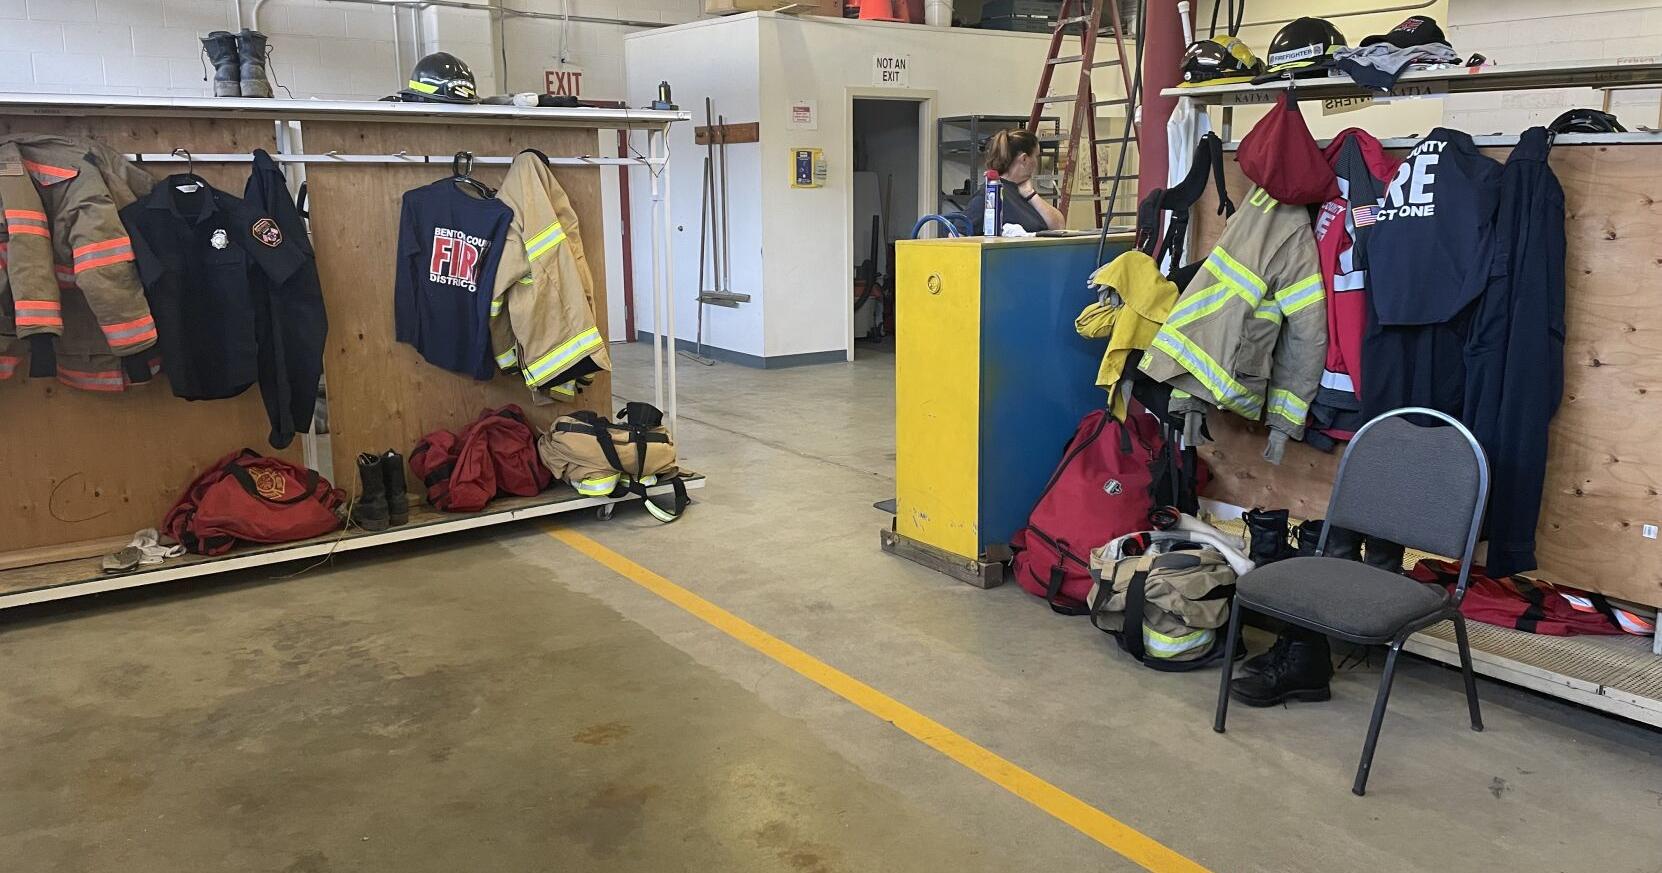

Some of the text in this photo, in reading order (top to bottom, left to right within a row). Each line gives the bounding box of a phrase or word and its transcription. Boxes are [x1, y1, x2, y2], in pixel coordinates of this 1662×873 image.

[876, 57, 906, 70] NOT AN
[1273, 49, 1313, 62] FIREFIGHTER
[545, 71, 582, 97] EXIT
[883, 71, 900, 82] EXIT
[1377, 205, 1435, 221] CT ONE
[435, 227, 487, 248] BENTO COU
[430, 235, 480, 284] FIR
[429, 273, 469, 289] DISTRIC
